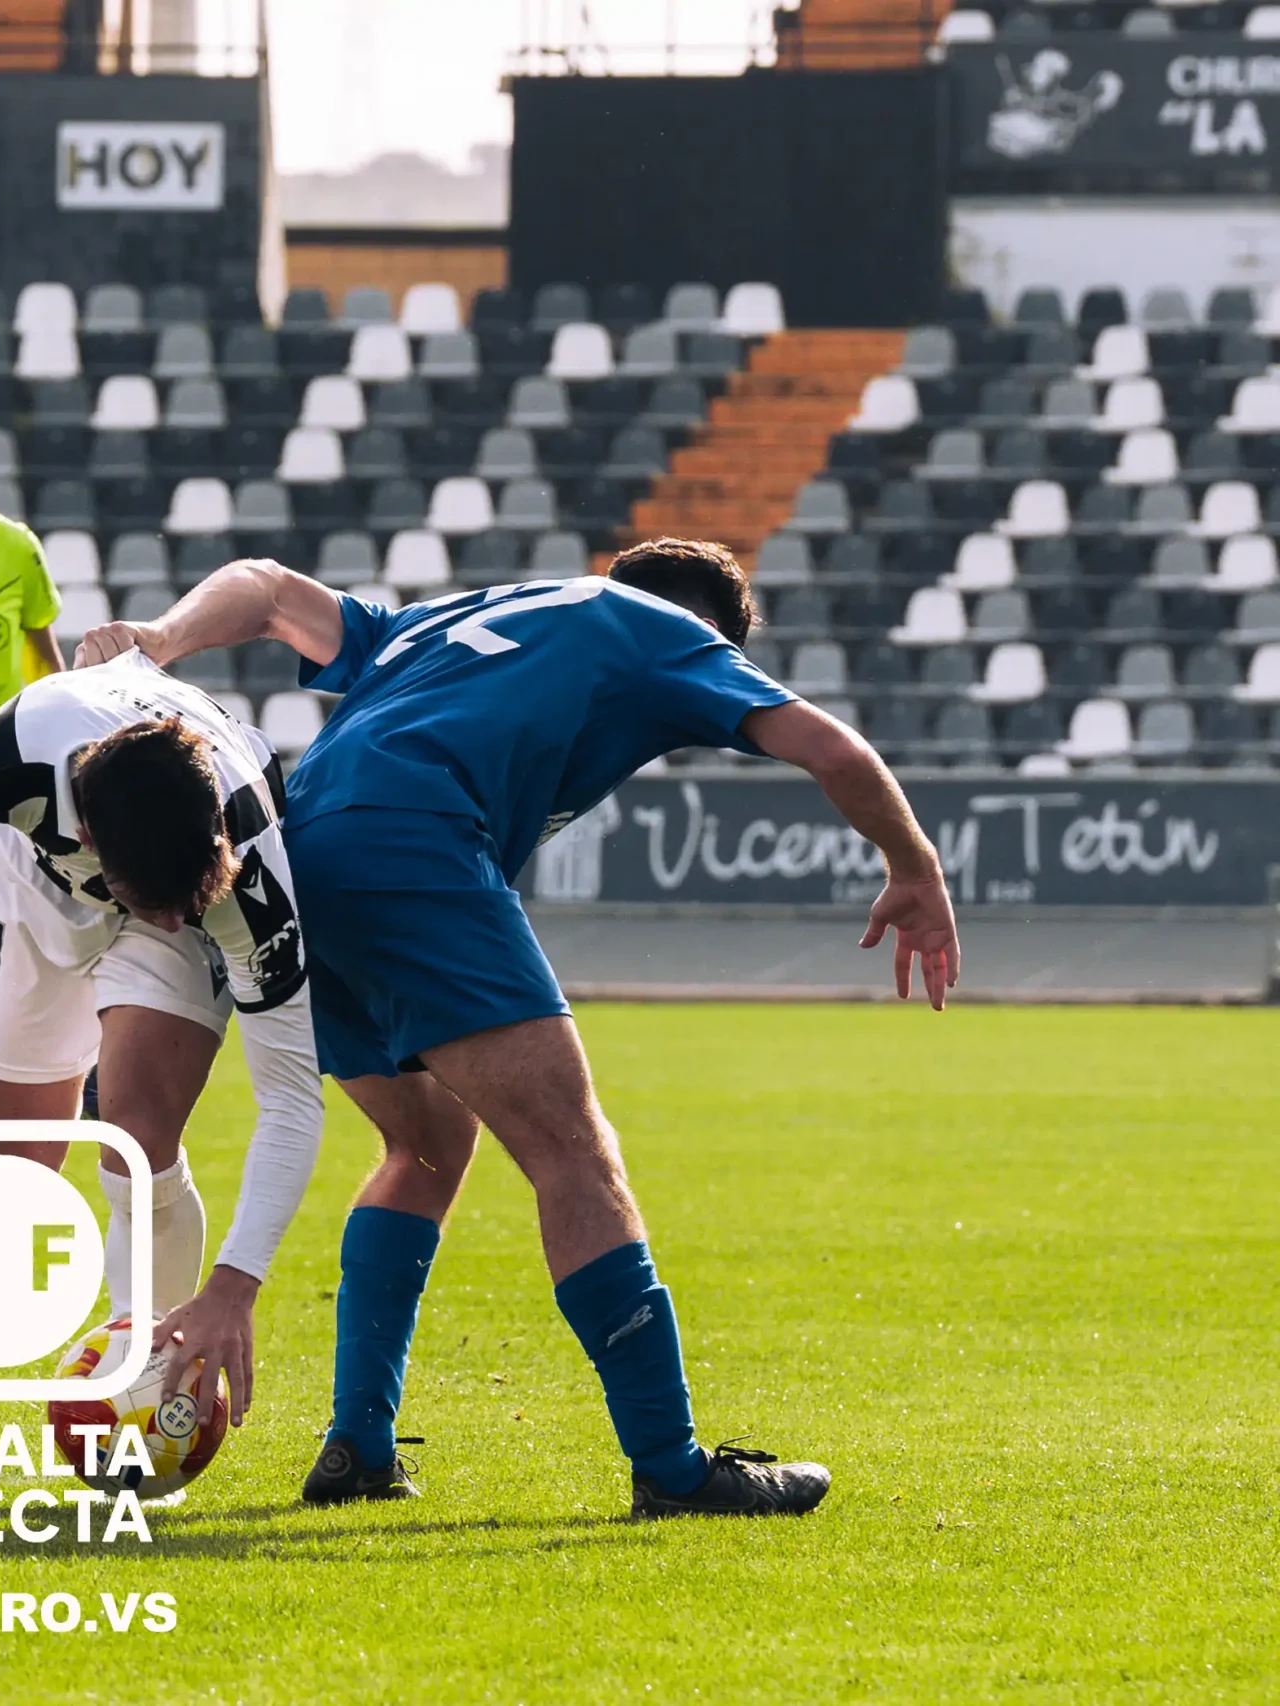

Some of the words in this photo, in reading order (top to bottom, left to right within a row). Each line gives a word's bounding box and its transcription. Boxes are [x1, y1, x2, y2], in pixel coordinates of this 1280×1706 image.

[66, 140, 210, 190] HOY
[633, 782, 887, 889] Vicent
[937, 817, 980, 902] y
